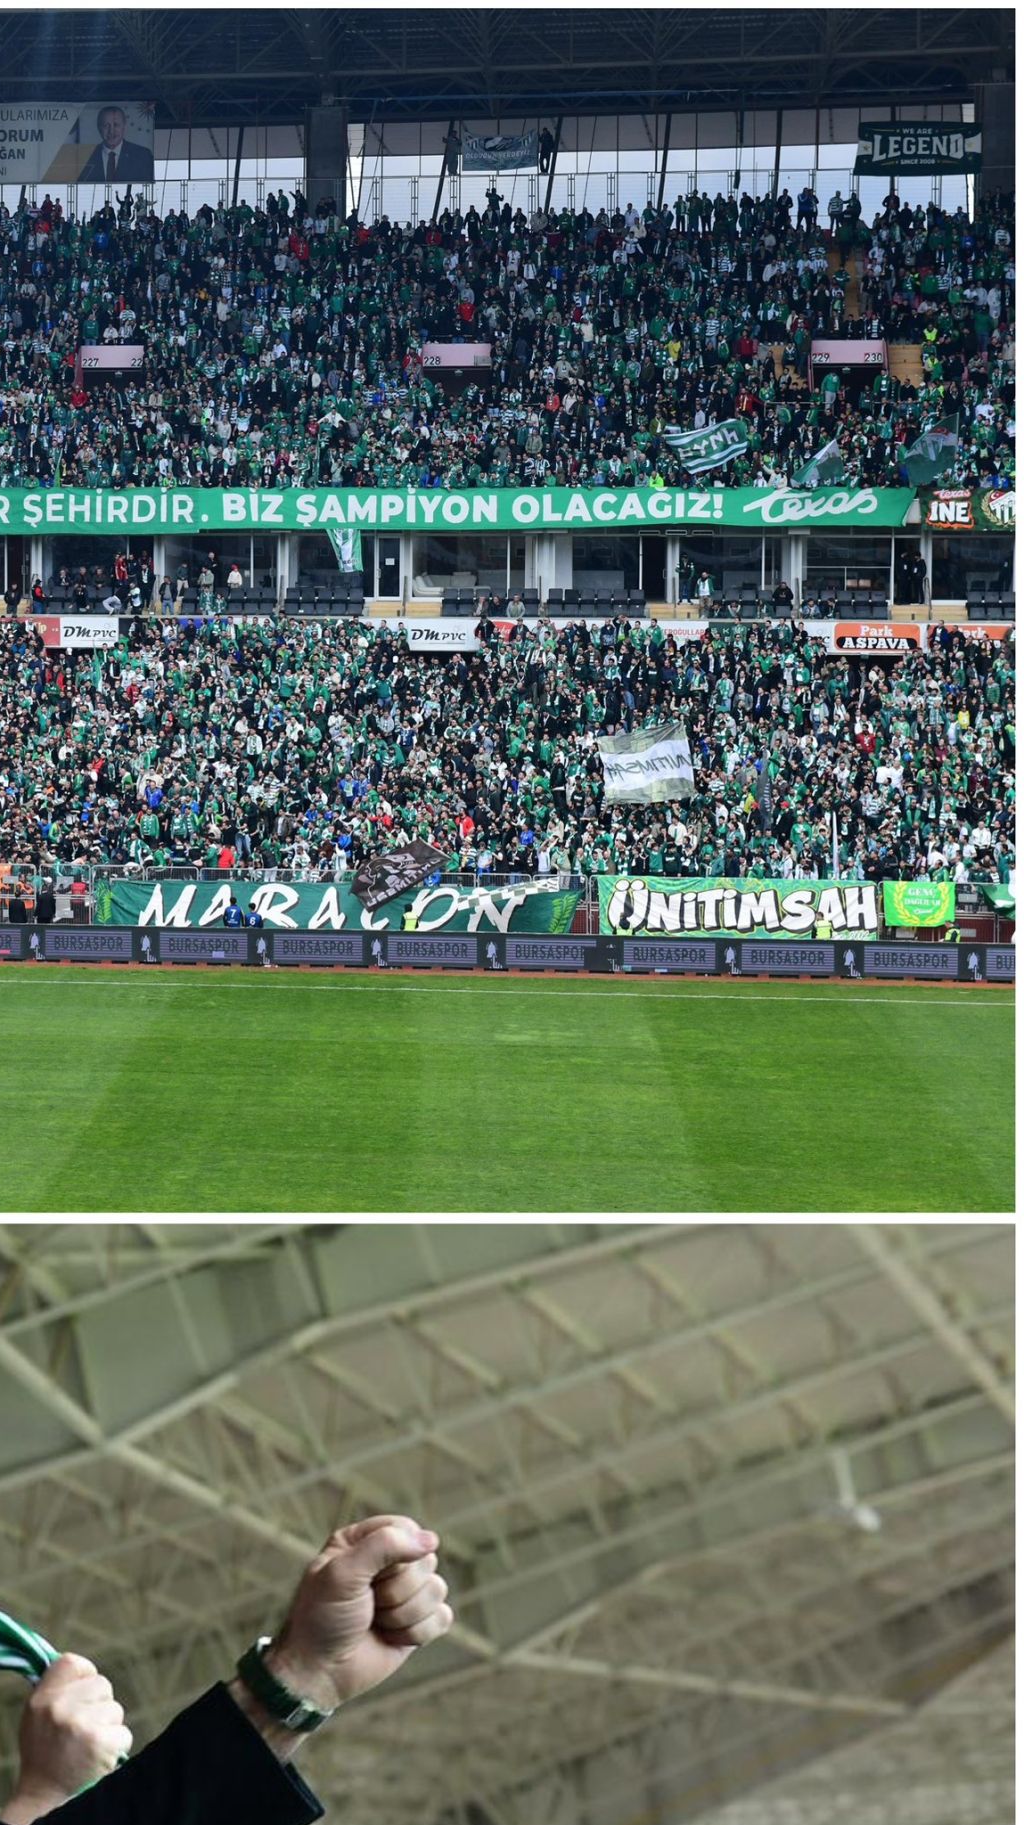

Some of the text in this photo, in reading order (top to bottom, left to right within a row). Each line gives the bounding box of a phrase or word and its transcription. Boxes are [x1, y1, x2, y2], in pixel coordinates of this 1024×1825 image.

[872, 133, 964, 161] LEGEND
[83, 357, 99, 366] 227
[423, 356, 441, 365] 228
[812, 353, 830, 362] 229
[864, 353, 883, 362] 230
[23, 488, 209, 526] ŞEHİRDİR.
[222, 488, 284, 523] BİZ
[296, 488, 503, 527] ŞAMPİYON
[512, 486, 724, 523] OLACAĞIZ!
[859, 624, 894, 637] Park
[958, 625, 987, 639] ark
[842, 636, 910, 650] ASPAVA
[230, 909, 236, 918] 7
[249, 917, 256, 925] 6
[54, 935, 123, 950] BURSASPOR
[168, 937, 239, 953] BURSASPOR
[282, 939, 354, 955] BURSASPOR
[396, 942, 468, 958] BURSASPOR
[633, 946, 706, 964] BURSASPOR
[750, 948, 825, 966] BURSASPOR
[874, 951, 949, 968] BURSASPOR
